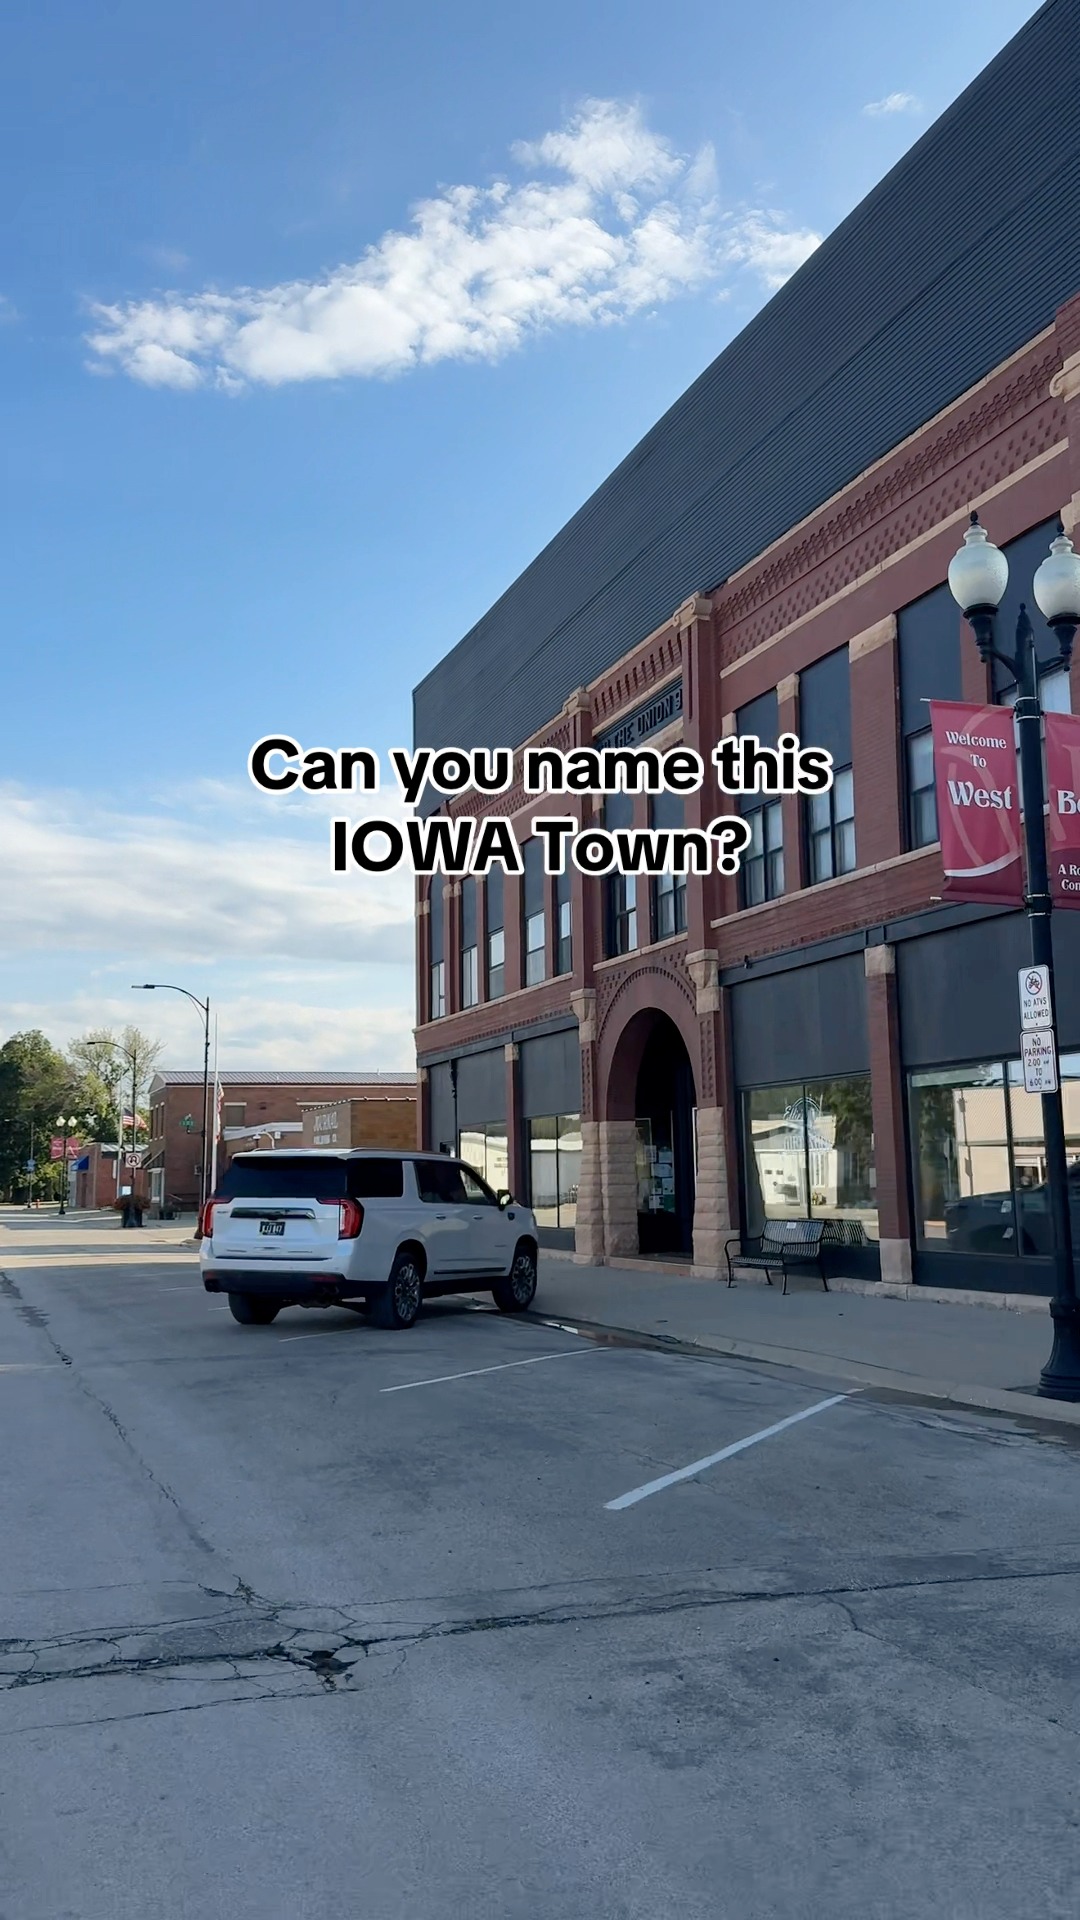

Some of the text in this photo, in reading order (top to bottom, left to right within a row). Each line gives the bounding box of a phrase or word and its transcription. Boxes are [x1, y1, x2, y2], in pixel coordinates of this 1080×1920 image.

[637, 695, 674, 737] UNION
[945, 731, 1008, 749] Welcome
[970, 754, 987, 768] To
[947, 779, 1013, 810] West
[1057, 863, 1067, 875] A
[1023, 999, 1032, 1008] NO
[1024, 1009, 1049, 1020] ALLOWED
[1032, 1037, 1041, 1046] NO
[1024, 1046, 1052, 1057] PARKING
